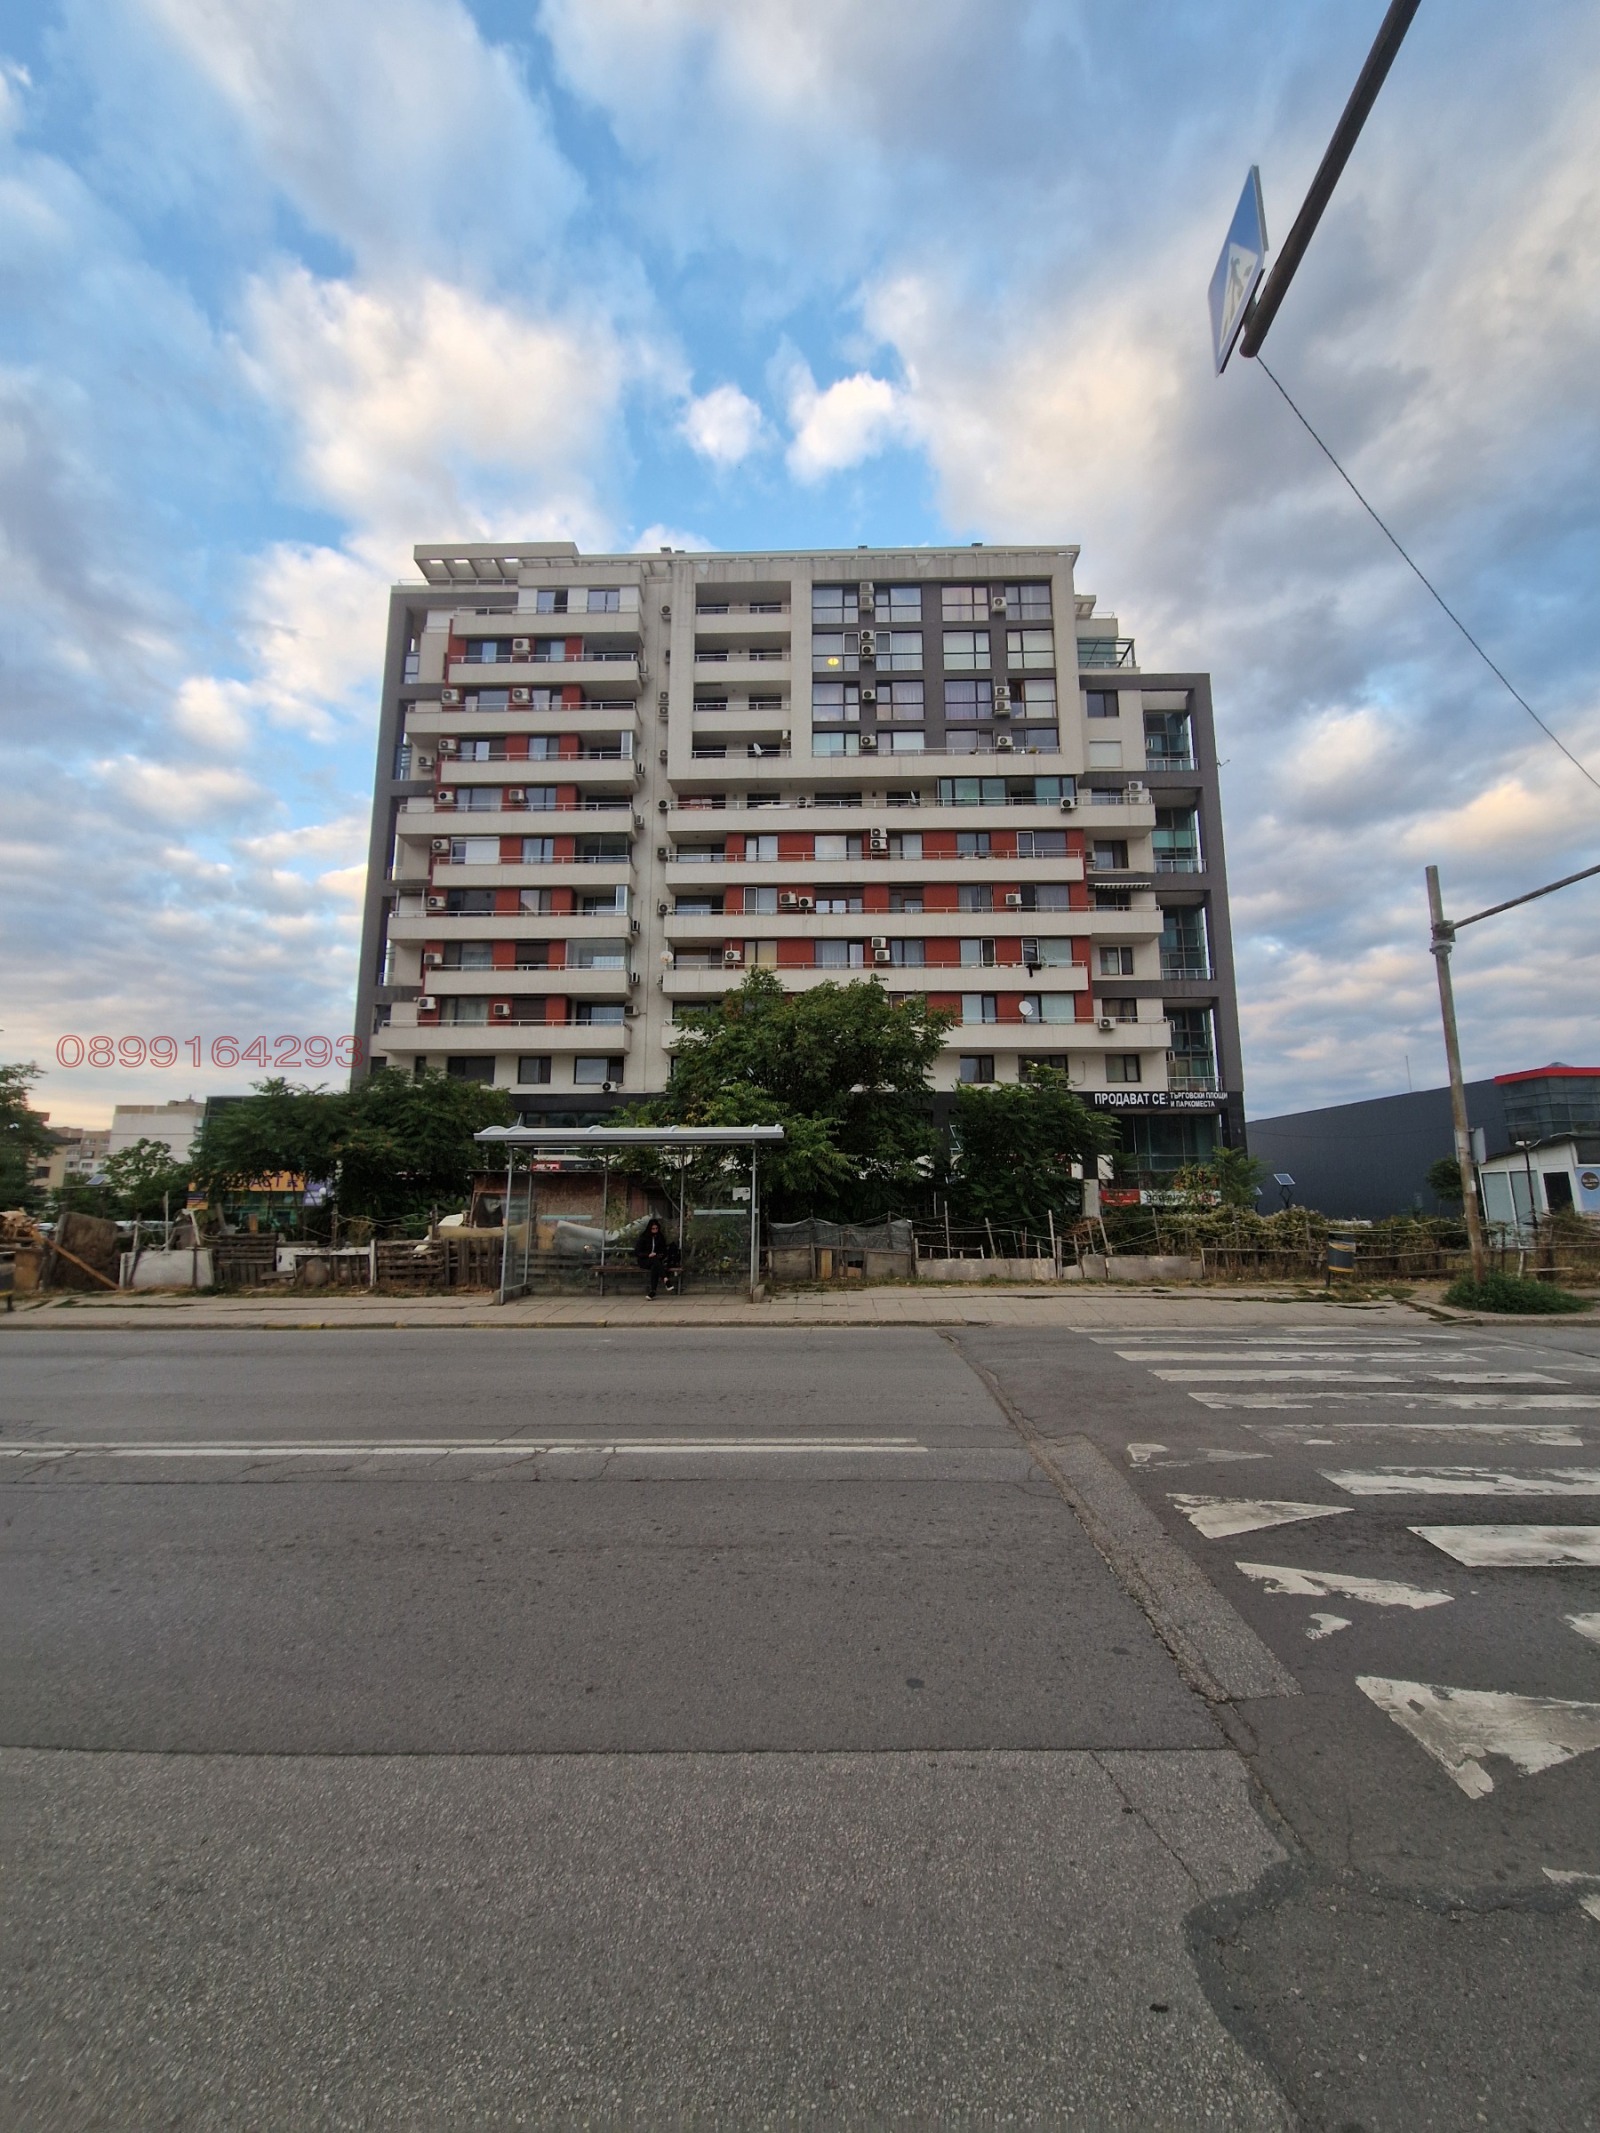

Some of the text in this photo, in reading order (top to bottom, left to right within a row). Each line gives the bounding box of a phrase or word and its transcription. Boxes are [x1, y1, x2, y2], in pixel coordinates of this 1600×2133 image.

[1094, 1092, 1150, 1107] ПРОДАВАТ
[1169, 1091, 1228, 1101] ТЪРГОВСКИ ПЛОЩИ
[1170, 1100, 1216, 1108] И ПАРКОМЕСТА
